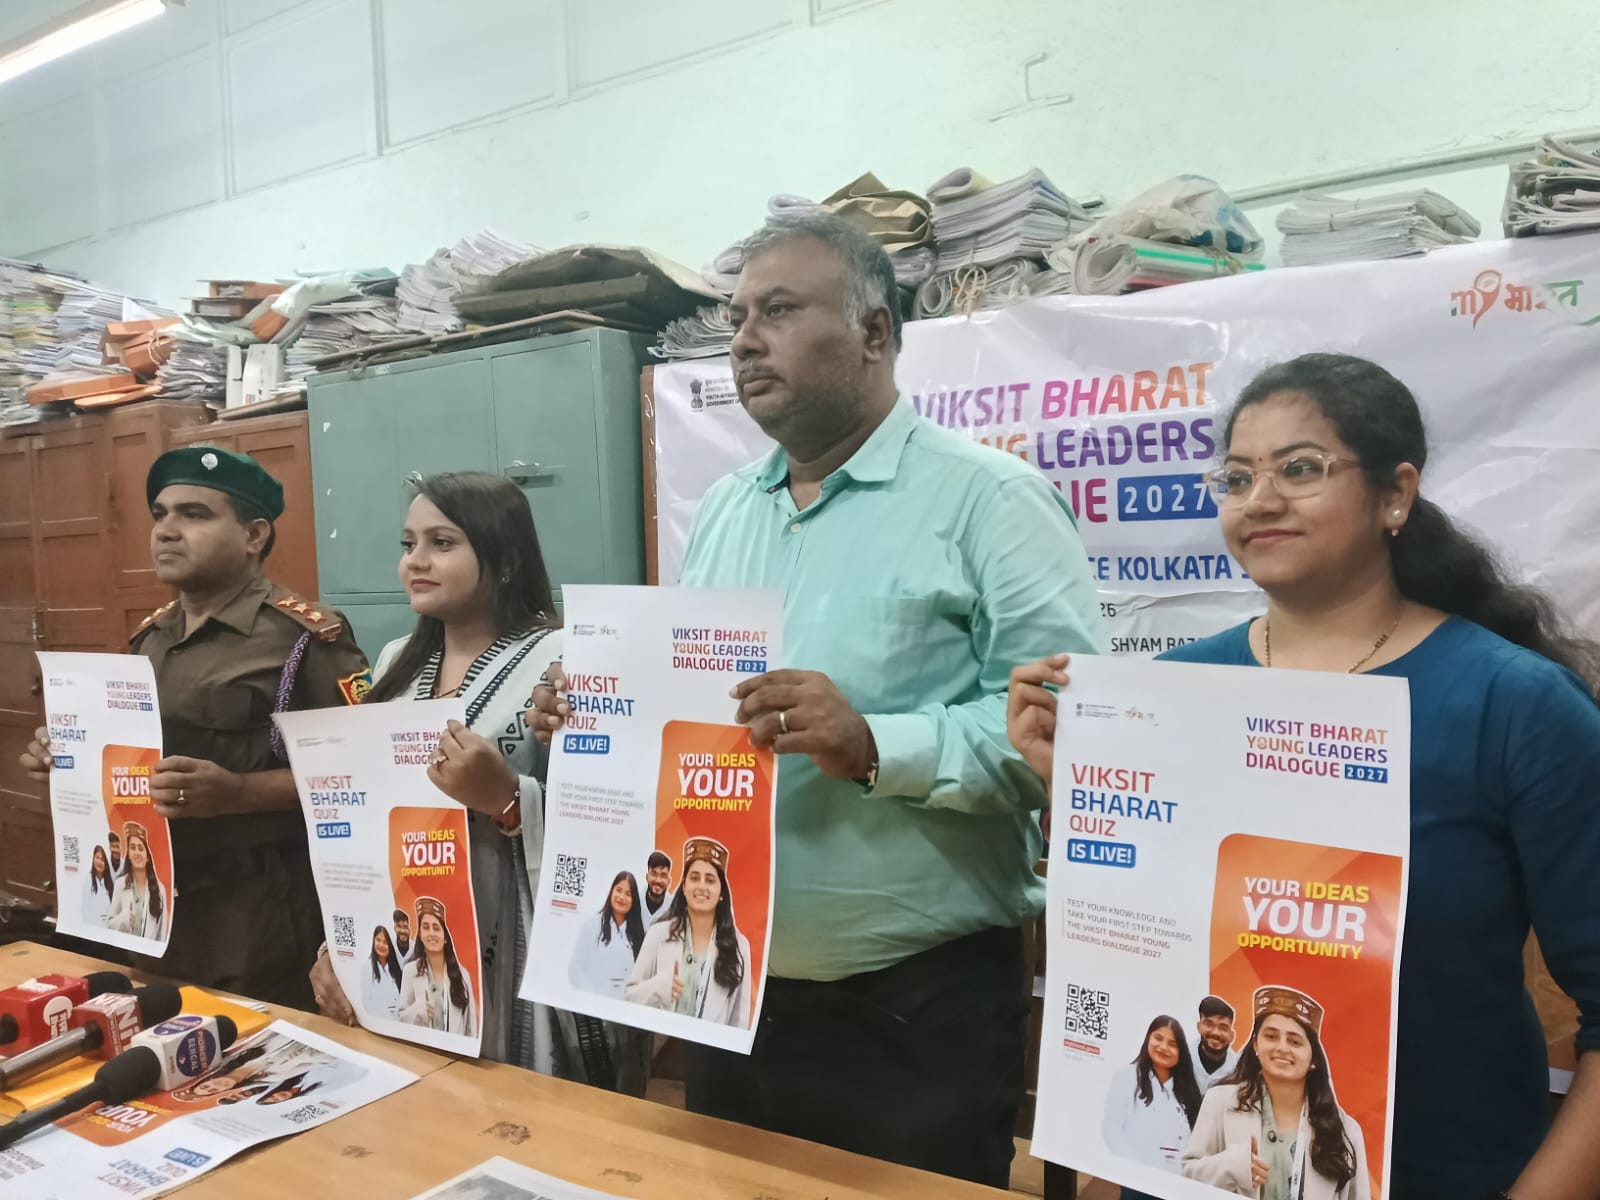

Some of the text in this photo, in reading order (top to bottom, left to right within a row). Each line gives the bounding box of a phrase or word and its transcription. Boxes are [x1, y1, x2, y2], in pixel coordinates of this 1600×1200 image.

[912, 362, 1215, 429] VIKSIT BHARAT
[1037, 418, 1215, 470] LEADERS
[1124, 483, 1208, 514] 2027
[1118, 554, 1233, 581] KOLKATA
[672, 628, 768, 643] VIKSIT BHARAT
[1111, 637, 1162, 652] SHYAM
[672, 642, 767, 657] YOUNG LEADERS
[673, 656, 765, 672] DIALOGUE 2027
[567, 673, 619, 694] VIKSIT
[567, 694, 635, 717] BHARAT
[50, 713, 78, 727] VIKSIT
[566, 715, 597, 731] QUIZ
[1247, 716, 1388, 745] VIKSIT BHARAT
[390, 732, 420, 742] VIKSIT
[393, 743, 422, 753] YOUNG
[566, 737, 608, 752] IS LIVE!
[678, 753, 756, 767] YOUR IDEAS
[1246, 735, 1388, 764] YOUNG LEADERS
[1072, 763, 1155, 793] VIKSIT
[1246, 752, 1386, 782] DIALOGUE 2027
[112, 777, 150, 796] YOUR
[305, 775, 352, 790] VIKSIT
[677, 768, 755, 797] YOUR
[311, 791, 366, 806] BHARAT
[673, 798, 753, 812] OPPORTUNITY
[1072, 789, 1178, 824] BHARAT
[313, 808, 339, 820] QUIZ
[1069, 814, 1116, 837] QUIZ
[401, 829, 455, 843] YOUR IDEAS
[401, 841, 456, 866] YOUR
[1071, 843, 1132, 864] IS LIVE!
[401, 865, 455, 877] OPPORTUNITY
[1244, 877, 1370, 904] YOUR IDEAS
[1067, 898, 1177, 927] TEST YOUR KNOWLEDGE AND
[1242, 896, 1367, 942] YOUR
[1067, 909, 1193, 942] TAKE YOUR FIRST STEP TOWARDS
[1067, 921, 1171, 949] THE VIKSIT BHARAT YOUNG
[1067, 932, 1162, 959] LEADERS DIALOGUE 2027
[1237, 933, 1363, 960] OPPORTUNITY
[96, 1171, 148, 1196] VIKSIT
[108, 1158, 171, 1187] BHARAT
